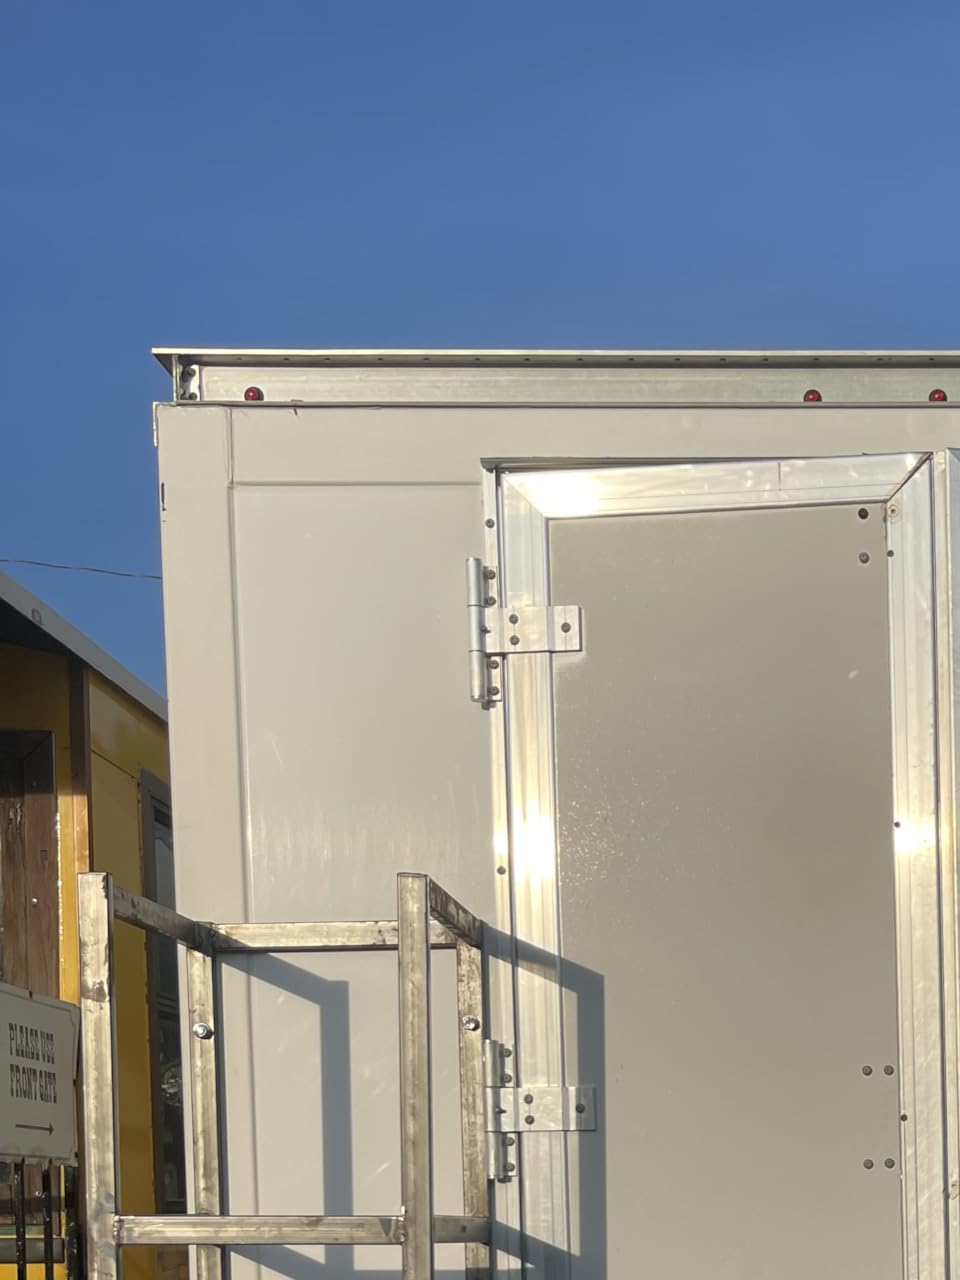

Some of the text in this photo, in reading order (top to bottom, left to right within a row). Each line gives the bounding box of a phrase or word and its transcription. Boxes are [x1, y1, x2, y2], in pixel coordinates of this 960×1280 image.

[8, 1022, 55, 1065] PLEASE USE
[10, 1063, 57, 1104] FRONT GATE
